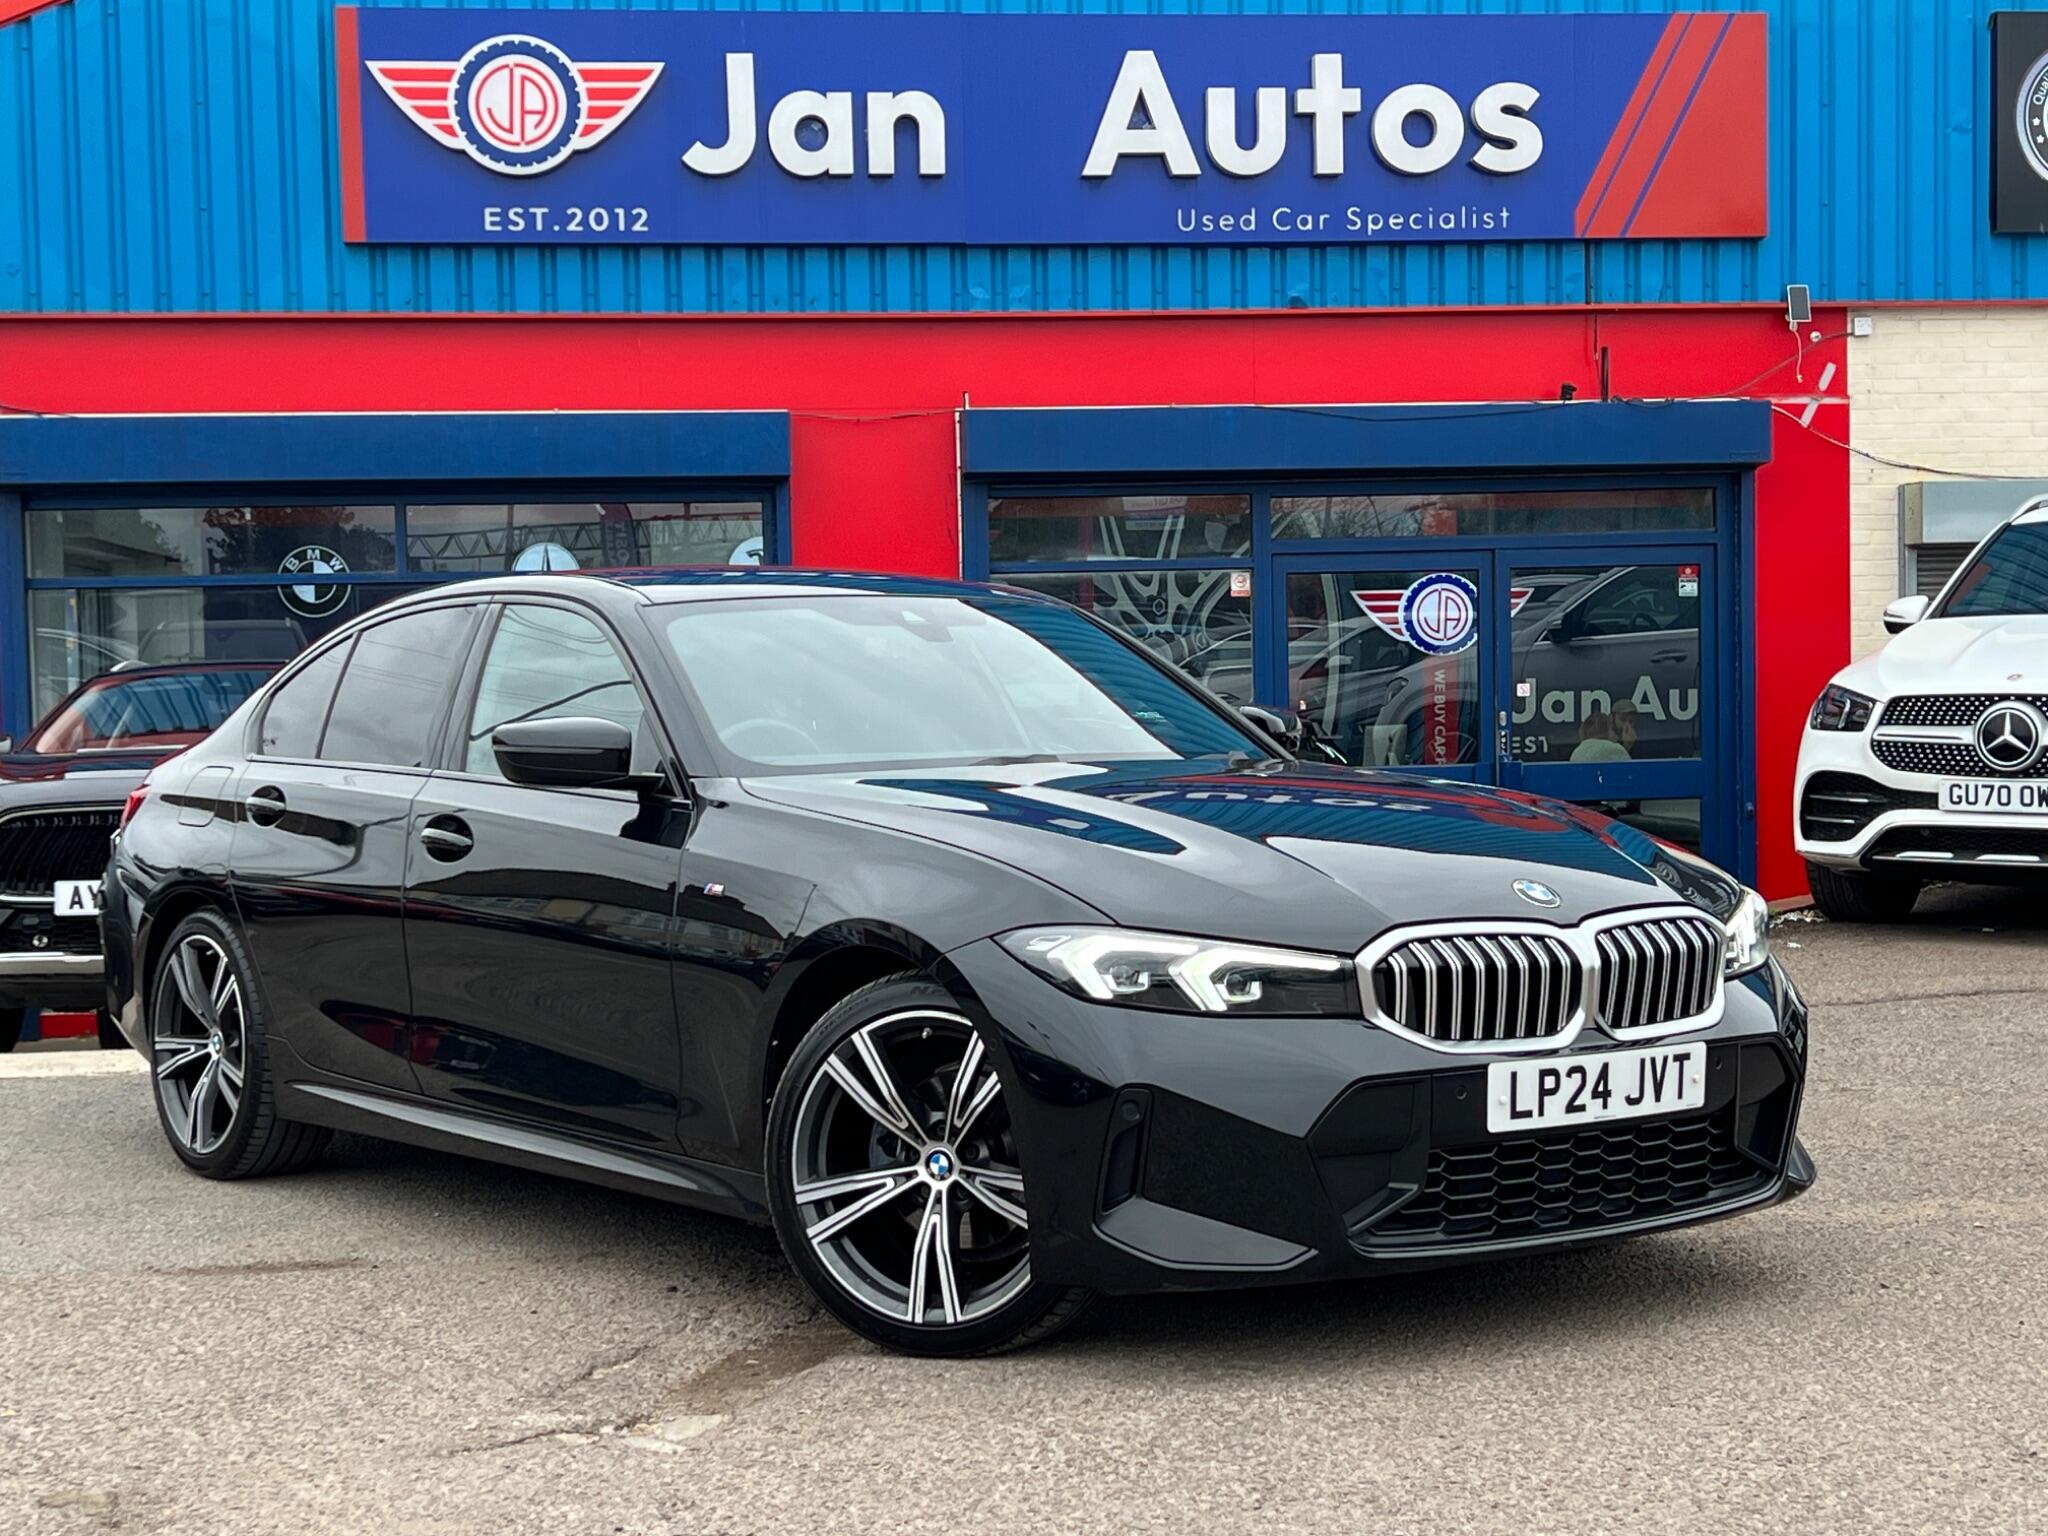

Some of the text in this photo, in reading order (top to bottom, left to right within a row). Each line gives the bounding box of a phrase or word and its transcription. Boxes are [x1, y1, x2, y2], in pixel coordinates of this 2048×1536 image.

[681, 50, 1545, 177] Jan Autos
[484, 207, 649, 232] EST.2012
[1177, 206, 1510, 236] Used Car Specialist
[284, 548, 344, 571] BMW
[1434, 669, 1446, 692] WE
[1434, 695, 1446, 722] BUY
[1512, 675, 1698, 724] Jan Au
[1949, 783, 2011, 806] GU70
[1510, 1053, 1691, 1120] LP24 JVT
